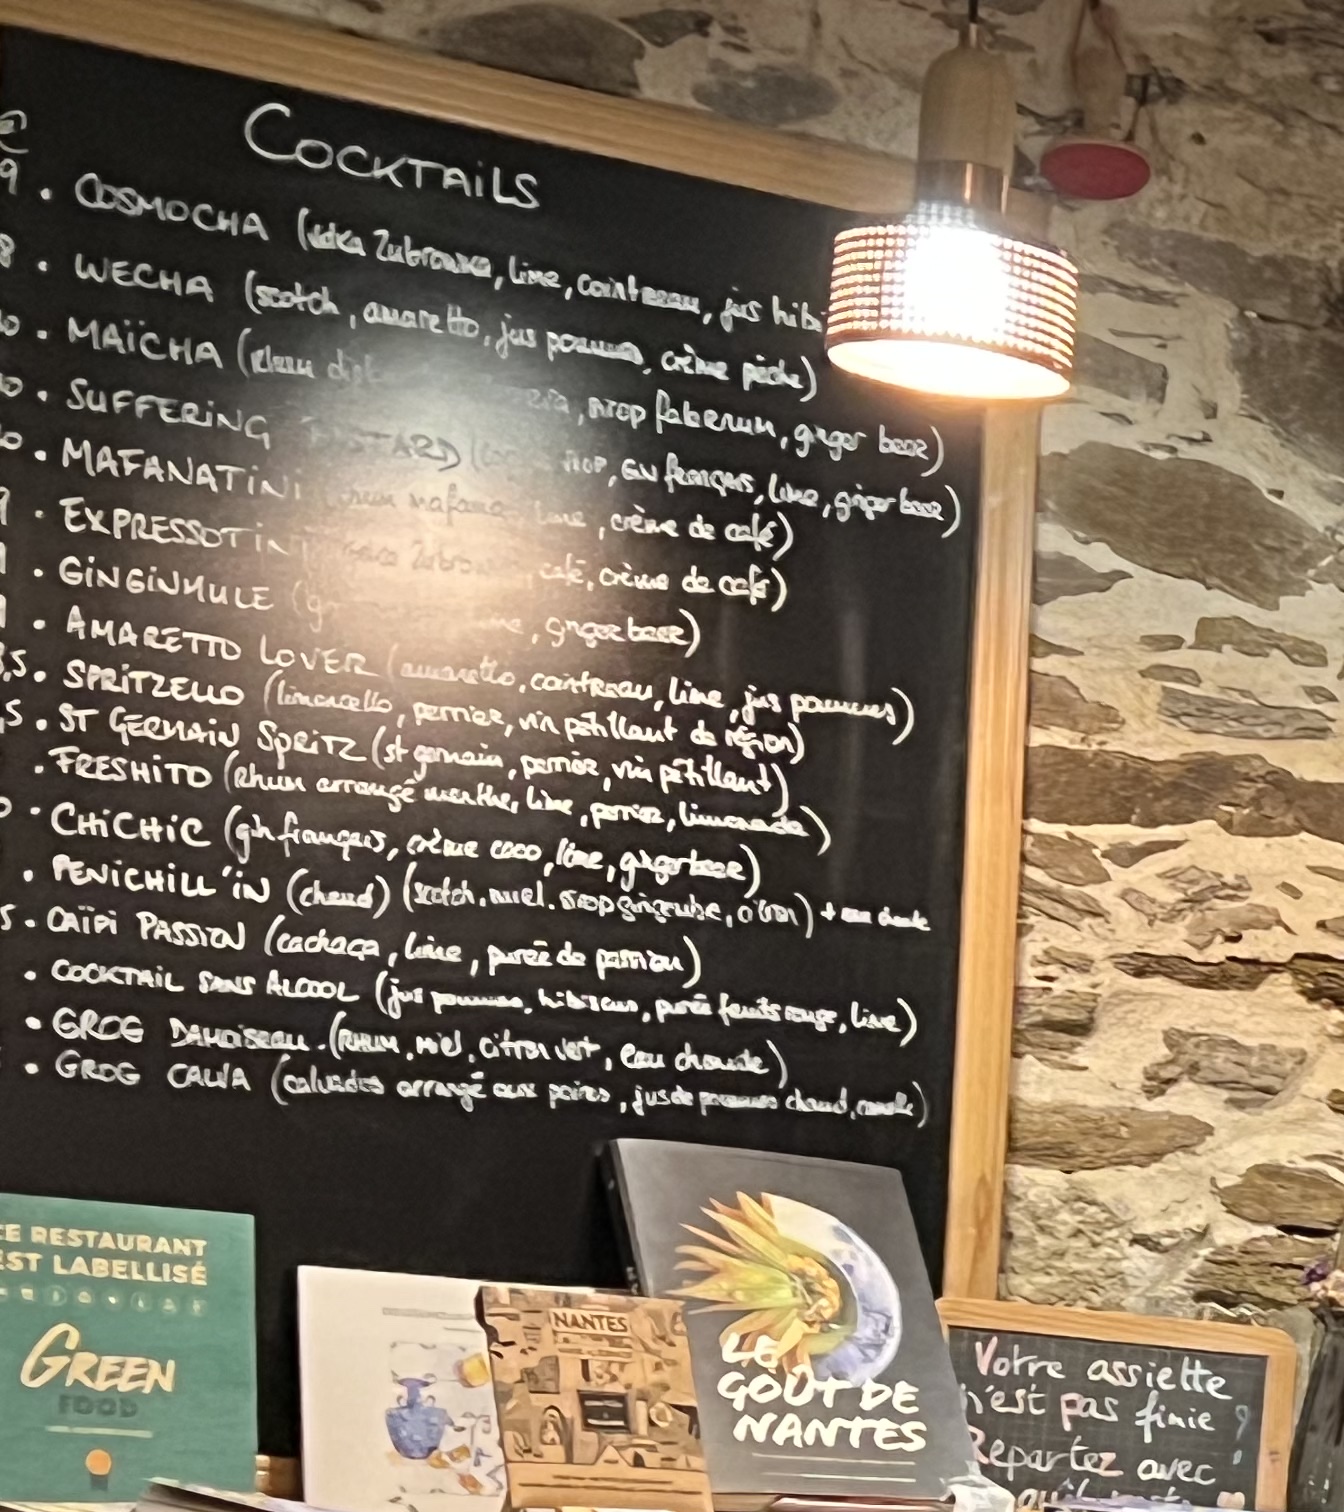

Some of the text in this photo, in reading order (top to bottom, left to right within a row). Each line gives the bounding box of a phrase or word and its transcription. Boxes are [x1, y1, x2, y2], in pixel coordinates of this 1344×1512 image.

[75, 254, 214, 303] WECHA
[66, 605, 241, 661] AMARETTO
[260, 635, 379, 677] LOVER
[59, 703, 98, 733] ST
[52, 1007, 145, 1043] GROG
[55, 1049, 141, 1088] GROG
[31, 1226, 207, 1256] RESTAURANT
[53, 1255, 208, 1286] LABELLISÉ
[552, 1312, 628, 1333] NANTES
[721, 1334, 780, 1372] LE
[975, 1336, 1233, 1400] Votre assiette
[58, 1394, 139, 1418] FOOD
[859, 1378, 919, 1414] DE
[733, 1412, 927, 1452] NANTES
[1061, 1393, 1119, 1432] pas
[1135, 1389, 1215, 1443] finie
[968, 1425, 1216, 1485] Repartez avec
